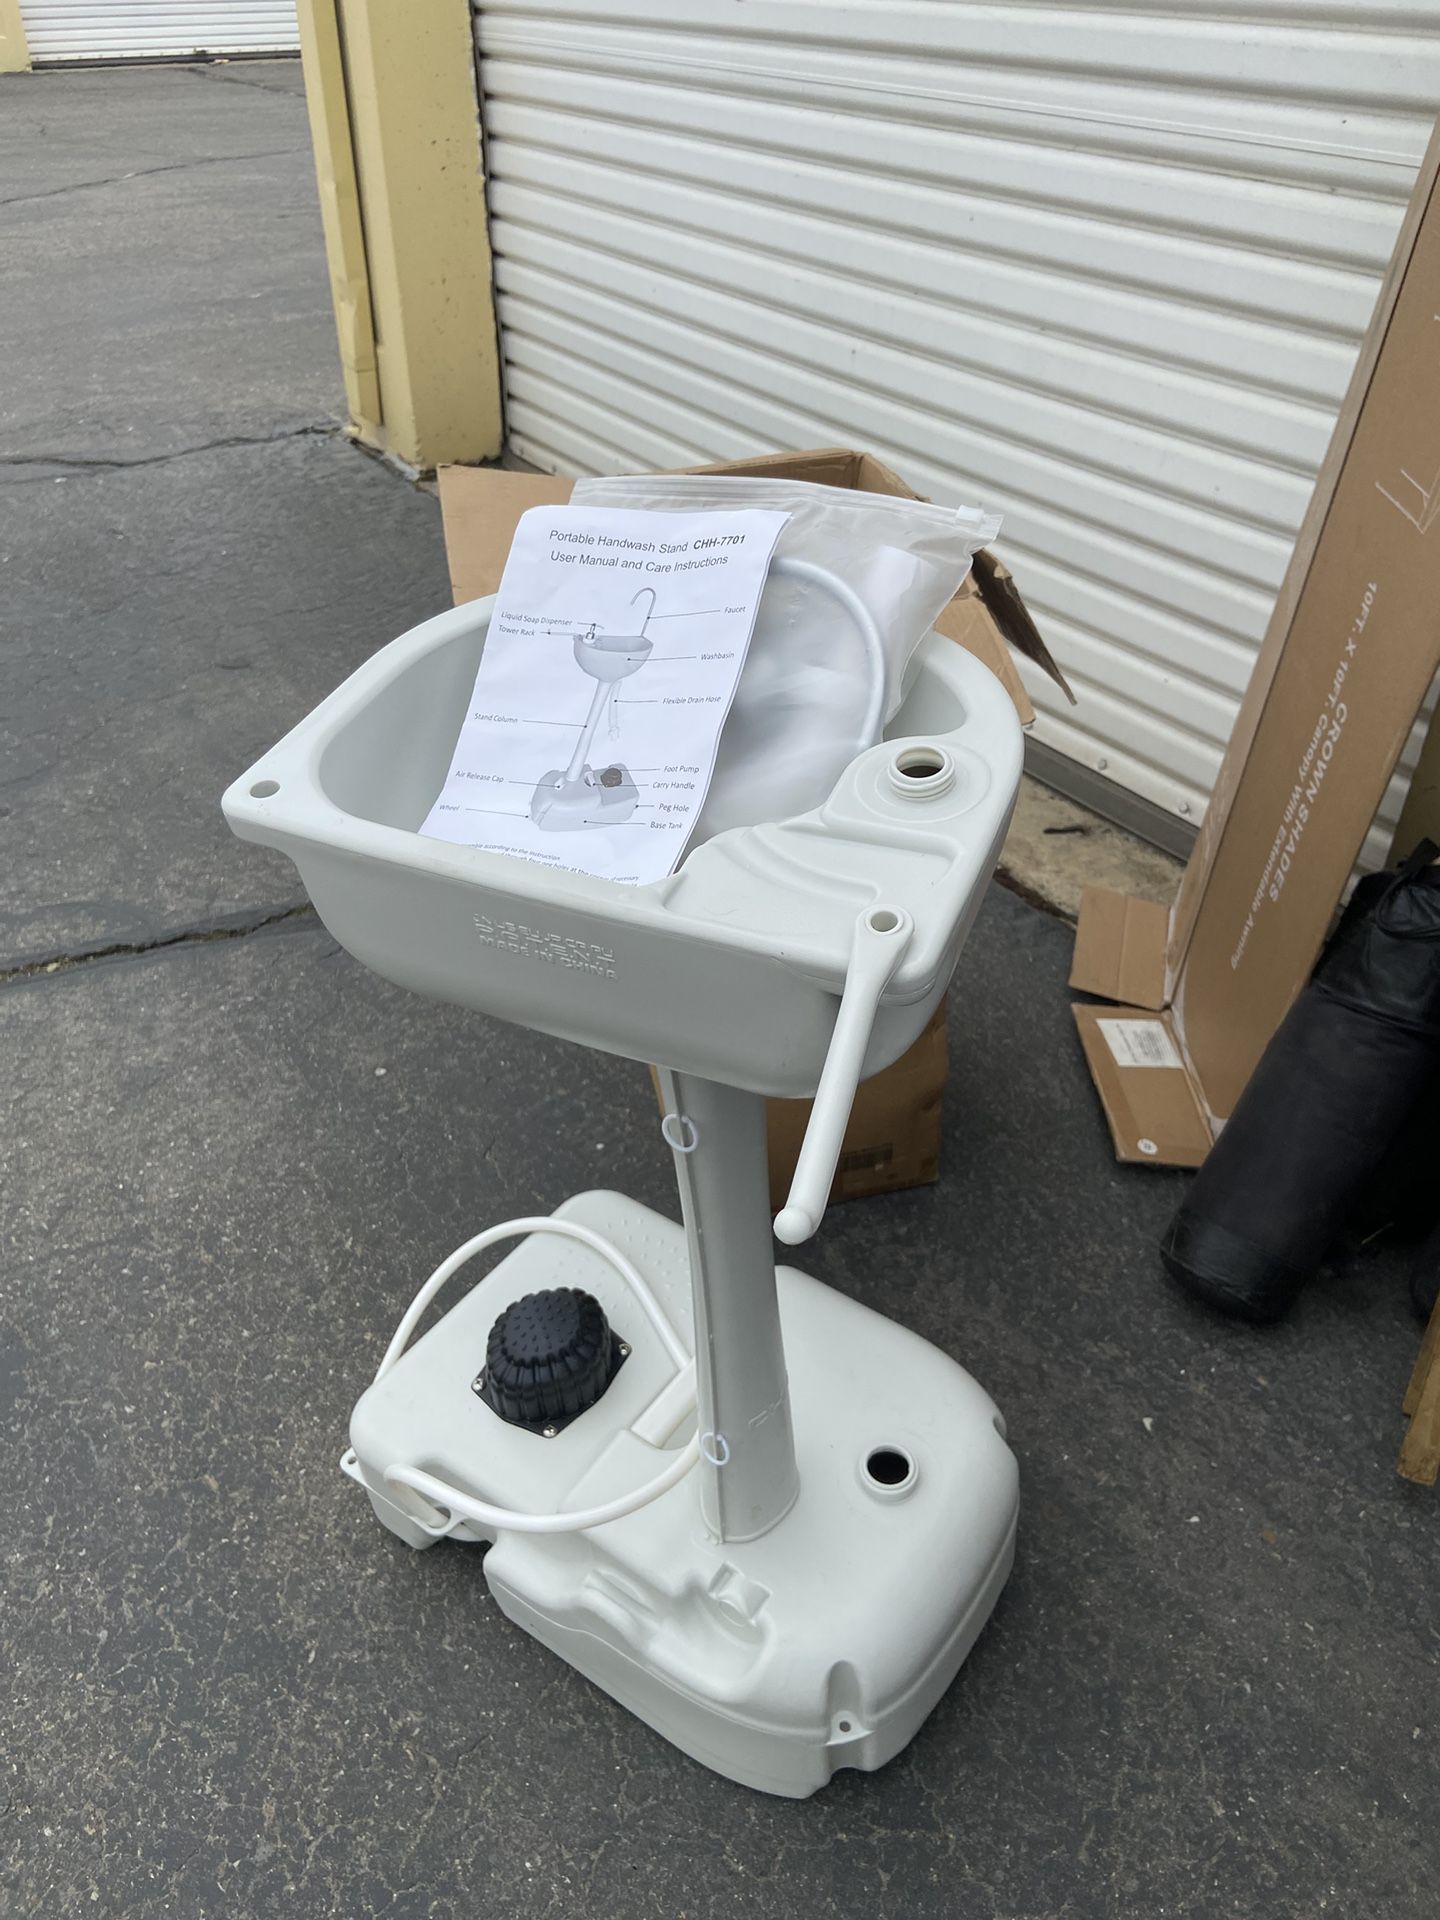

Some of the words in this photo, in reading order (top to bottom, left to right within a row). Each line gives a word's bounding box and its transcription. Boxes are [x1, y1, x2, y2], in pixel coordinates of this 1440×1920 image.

[550, 530, 595, 545] Portable
[597, 535, 656, 552] Handwash
[659, 542, 688, 554] Stand
[693, 534, 746, 550] CHH-7701
[550, 550, 577, 563] User
[579, 554, 619, 567] Manual
[621, 559, 643, 570] and
[645, 561, 671, 573] Care
[673, 556, 729, 572] Instructions
[724, 606, 746, 614] Faucet
[1352, 582, 1378, 633] 10FT.
[501, 611, 523, 621] Liquid
[523, 615, 540, 624] Soap
[540, 617, 573, 626] Dispenser
[499, 624, 519, 633] Tower
[1345, 637, 1357, 657] X
[701, 652, 735, 660] Washbasin
[1324, 660, 1348, 708] 10FT.
[687, 696, 705, 704] Drain
[474, 712, 493, 720] Stand
[493, 714, 518, 723] Column
[1295, 713, 1328, 783] Canopy
[1305, 702, 1348, 804] CROWN
[466, 771, 491, 781] Release
[491, 775, 505, 783] Cap
[679, 765, 699, 774] Pump
[670, 781, 695, 790] Handle
[659, 802, 672, 813] Peg
[672, 804, 690, 813] Hole
[1283, 784, 1302, 823] With
[650, 820, 667, 829] Base
[1269, 803, 1310, 902] SHADES
[1251, 825, 1287, 912] Extendable
[1230, 913, 1255, 971] Awning
